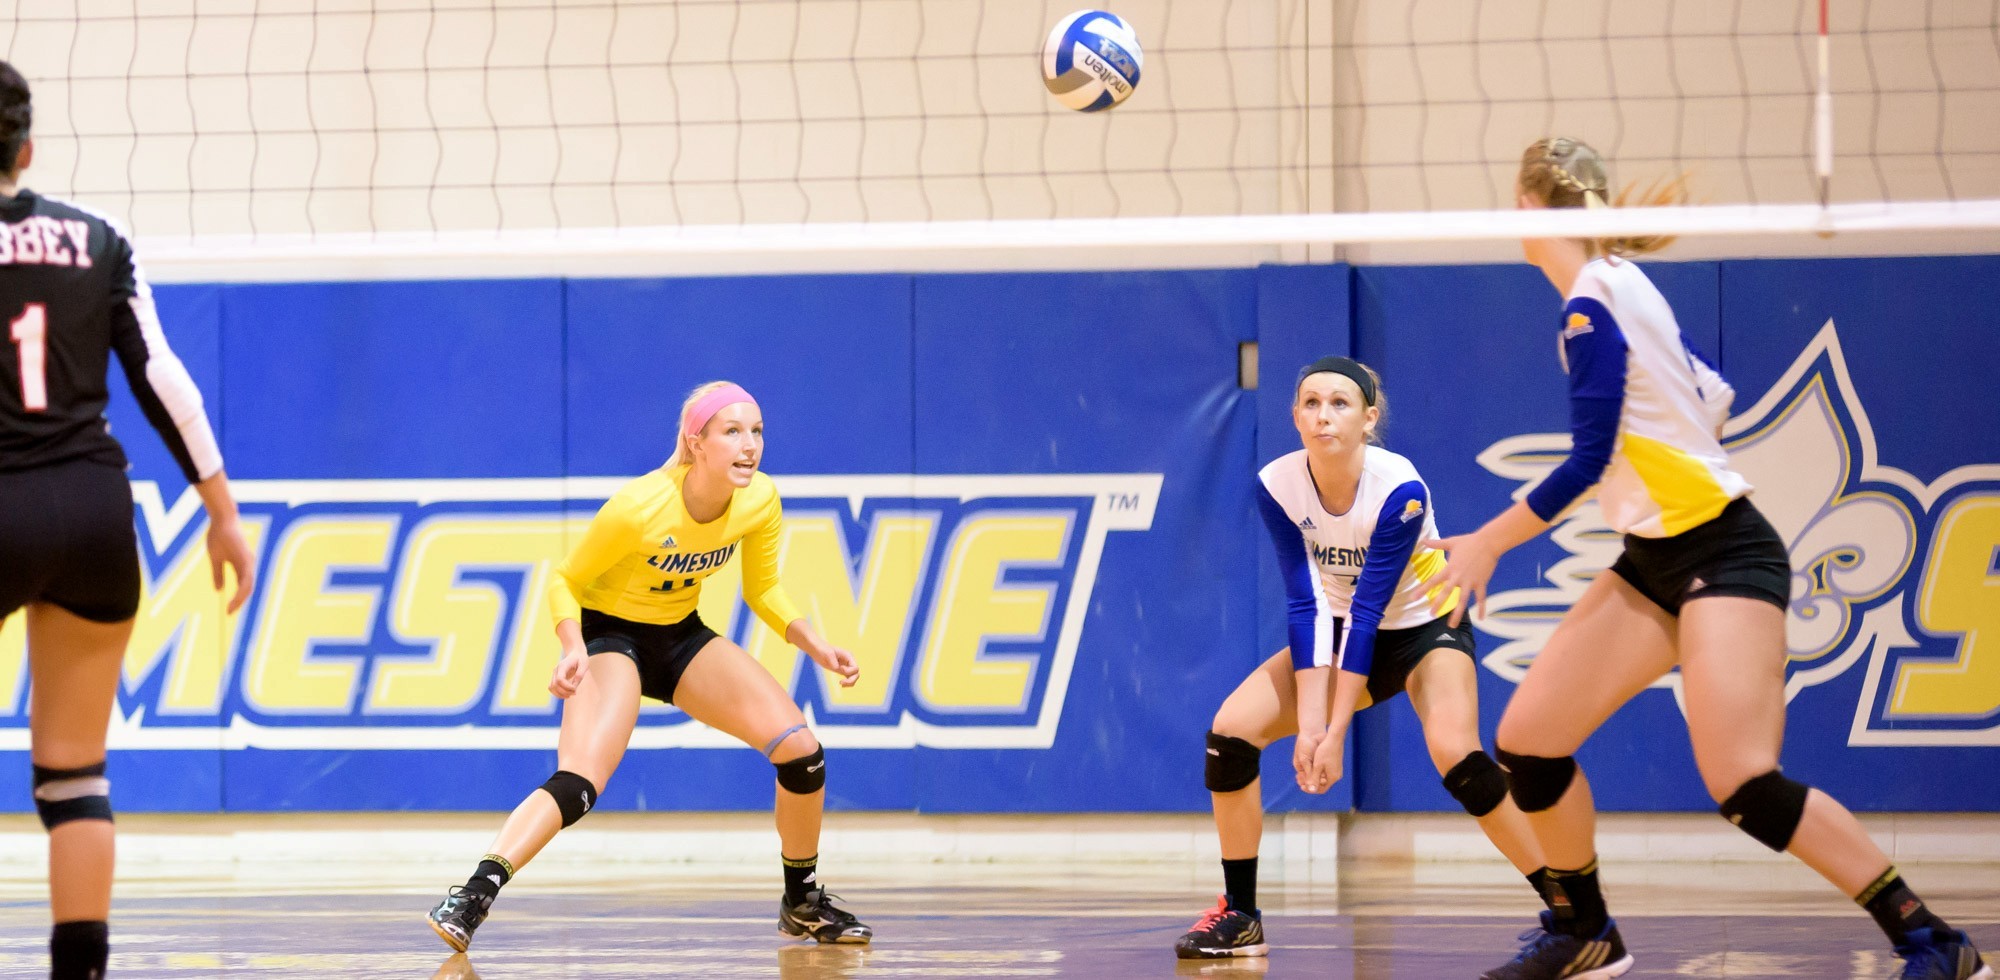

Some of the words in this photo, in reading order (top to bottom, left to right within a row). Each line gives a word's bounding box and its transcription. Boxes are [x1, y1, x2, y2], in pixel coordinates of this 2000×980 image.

[1084, 54, 1128, 94] molten
[9, 302, 48, 413] 1
[1107, 492, 1140, 511] TM
[647, 534, 744, 574] LIMESTON
